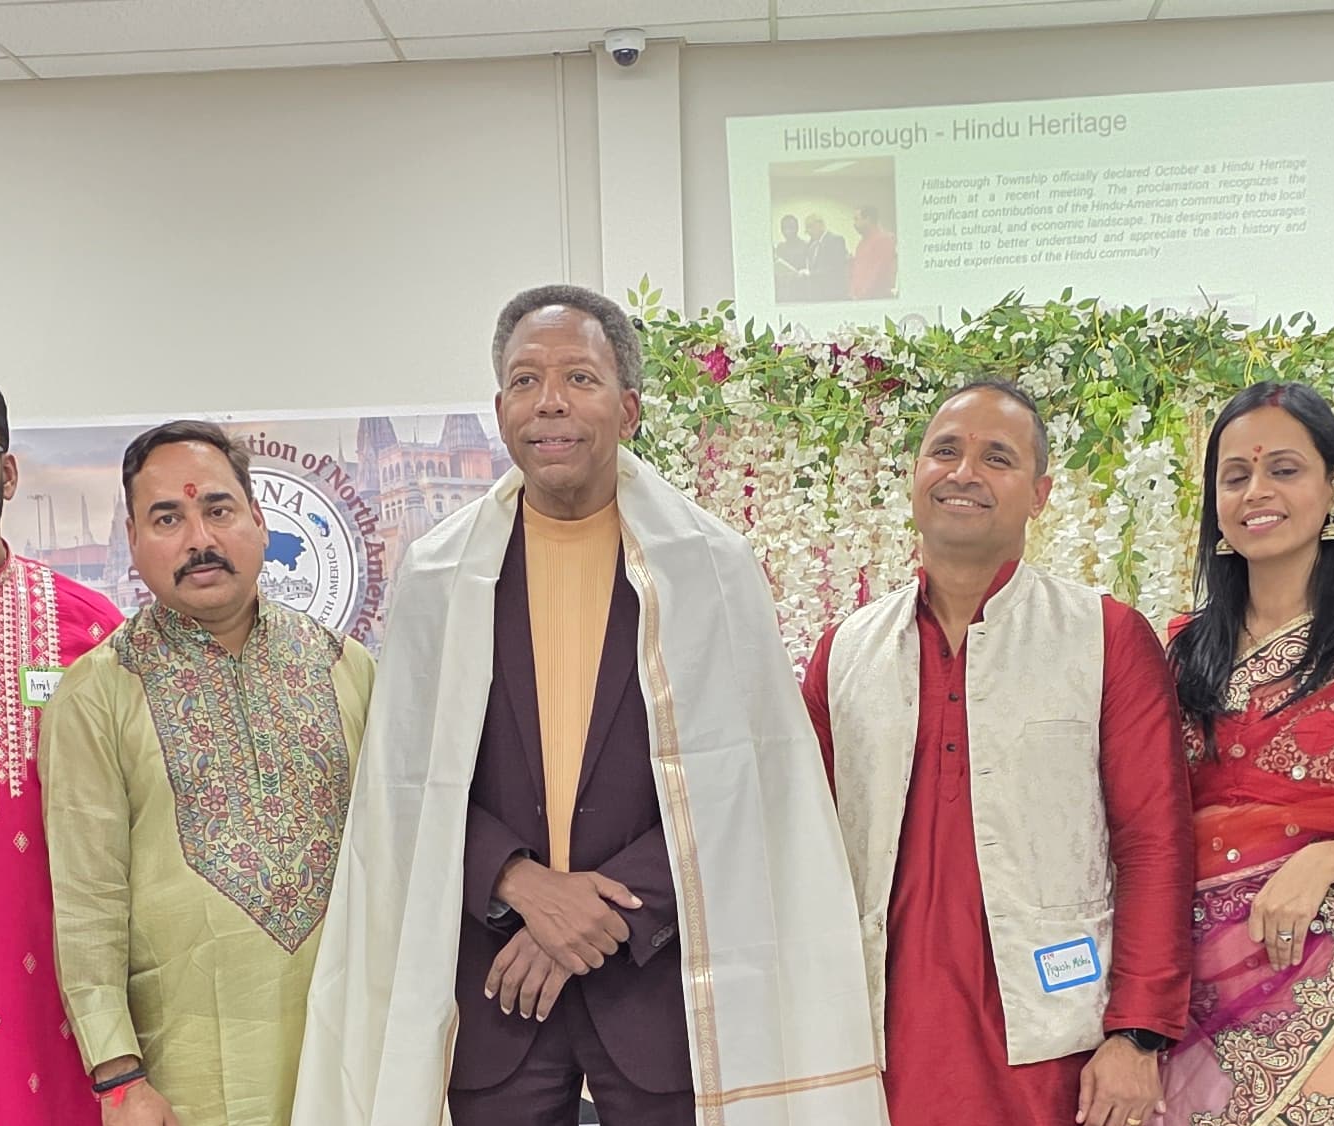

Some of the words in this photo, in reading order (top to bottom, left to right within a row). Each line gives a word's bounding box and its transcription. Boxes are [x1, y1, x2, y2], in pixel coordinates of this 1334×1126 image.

[783, 122, 928, 151] Hillsborough
[953, 117, 1020, 142] Hindu
[1029, 111, 1128, 138] Heritage
[922, 175, 990, 191] Hillsborough
[996, 174, 1048, 187] Township
[1052, 169, 1098, 184] officially
[1103, 166, 1150, 180] declared
[1154, 164, 1199, 177] October
[1203, 164, 1216, 174] as
[1222, 160, 1255, 173] Hindu
[1259, 157, 1308, 172] Heritage
[922, 193, 957, 207] Month
[967, 192, 979, 204] at
[988, 193, 996, 202] a
[1005, 189, 1040, 202] recent
[1107, 183, 1128, 195] The
[1136, 179, 1210, 196] proclamation
[1218, 176, 1280, 190] recognizes
[1289, 173, 1307, 185] the
[922, 207, 979, 224] significant
[981, 203, 1054, 218] contributions
[1056, 202, 1069, 214] of
[1071, 201, 1089, 213] the
[1091, 195, 1179, 213] Hindu-American
[1181, 192, 1244, 208] community
[1245, 191, 1257, 202] to
[1259, 189, 1278, 201] the
[1279, 188, 1307, 201] local
[1006, 220, 1028, 233] and
[1030, 217, 1084, 232] economic
[1150, 212, 1173, 225] This
[1175, 209, 1240, 225] designation
[1242, 205, 1307, 220] encourages
[923, 239, 974, 254] residents
[980, 239, 991, 251] to
[997, 237, 1030, 250] better
[1035, 232, 1098, 248] understand
[1103, 230, 1124, 243] and
[1129, 227, 1187, 243] appreciate
[1192, 226, 1211, 238] the
[1216, 224, 1237, 237] rich
[1242, 221, 1281, 236] history
[1285, 219, 1308, 232] and
[924, 256, 962, 270] shared
[964, 253, 1028, 269] experiences
[1030, 250, 1044, 264] of
[1045, 250, 1063, 262] the
[1064, 247, 1097, 262] Hindu
[246, 432, 298, 463] tion
[301, 453, 333, 477] of
[325, 465, 380, 537] North
[325, 542, 340, 600] AMERICA
[351, 539, 388, 643] America
[318, 600, 336, 625] RTH
